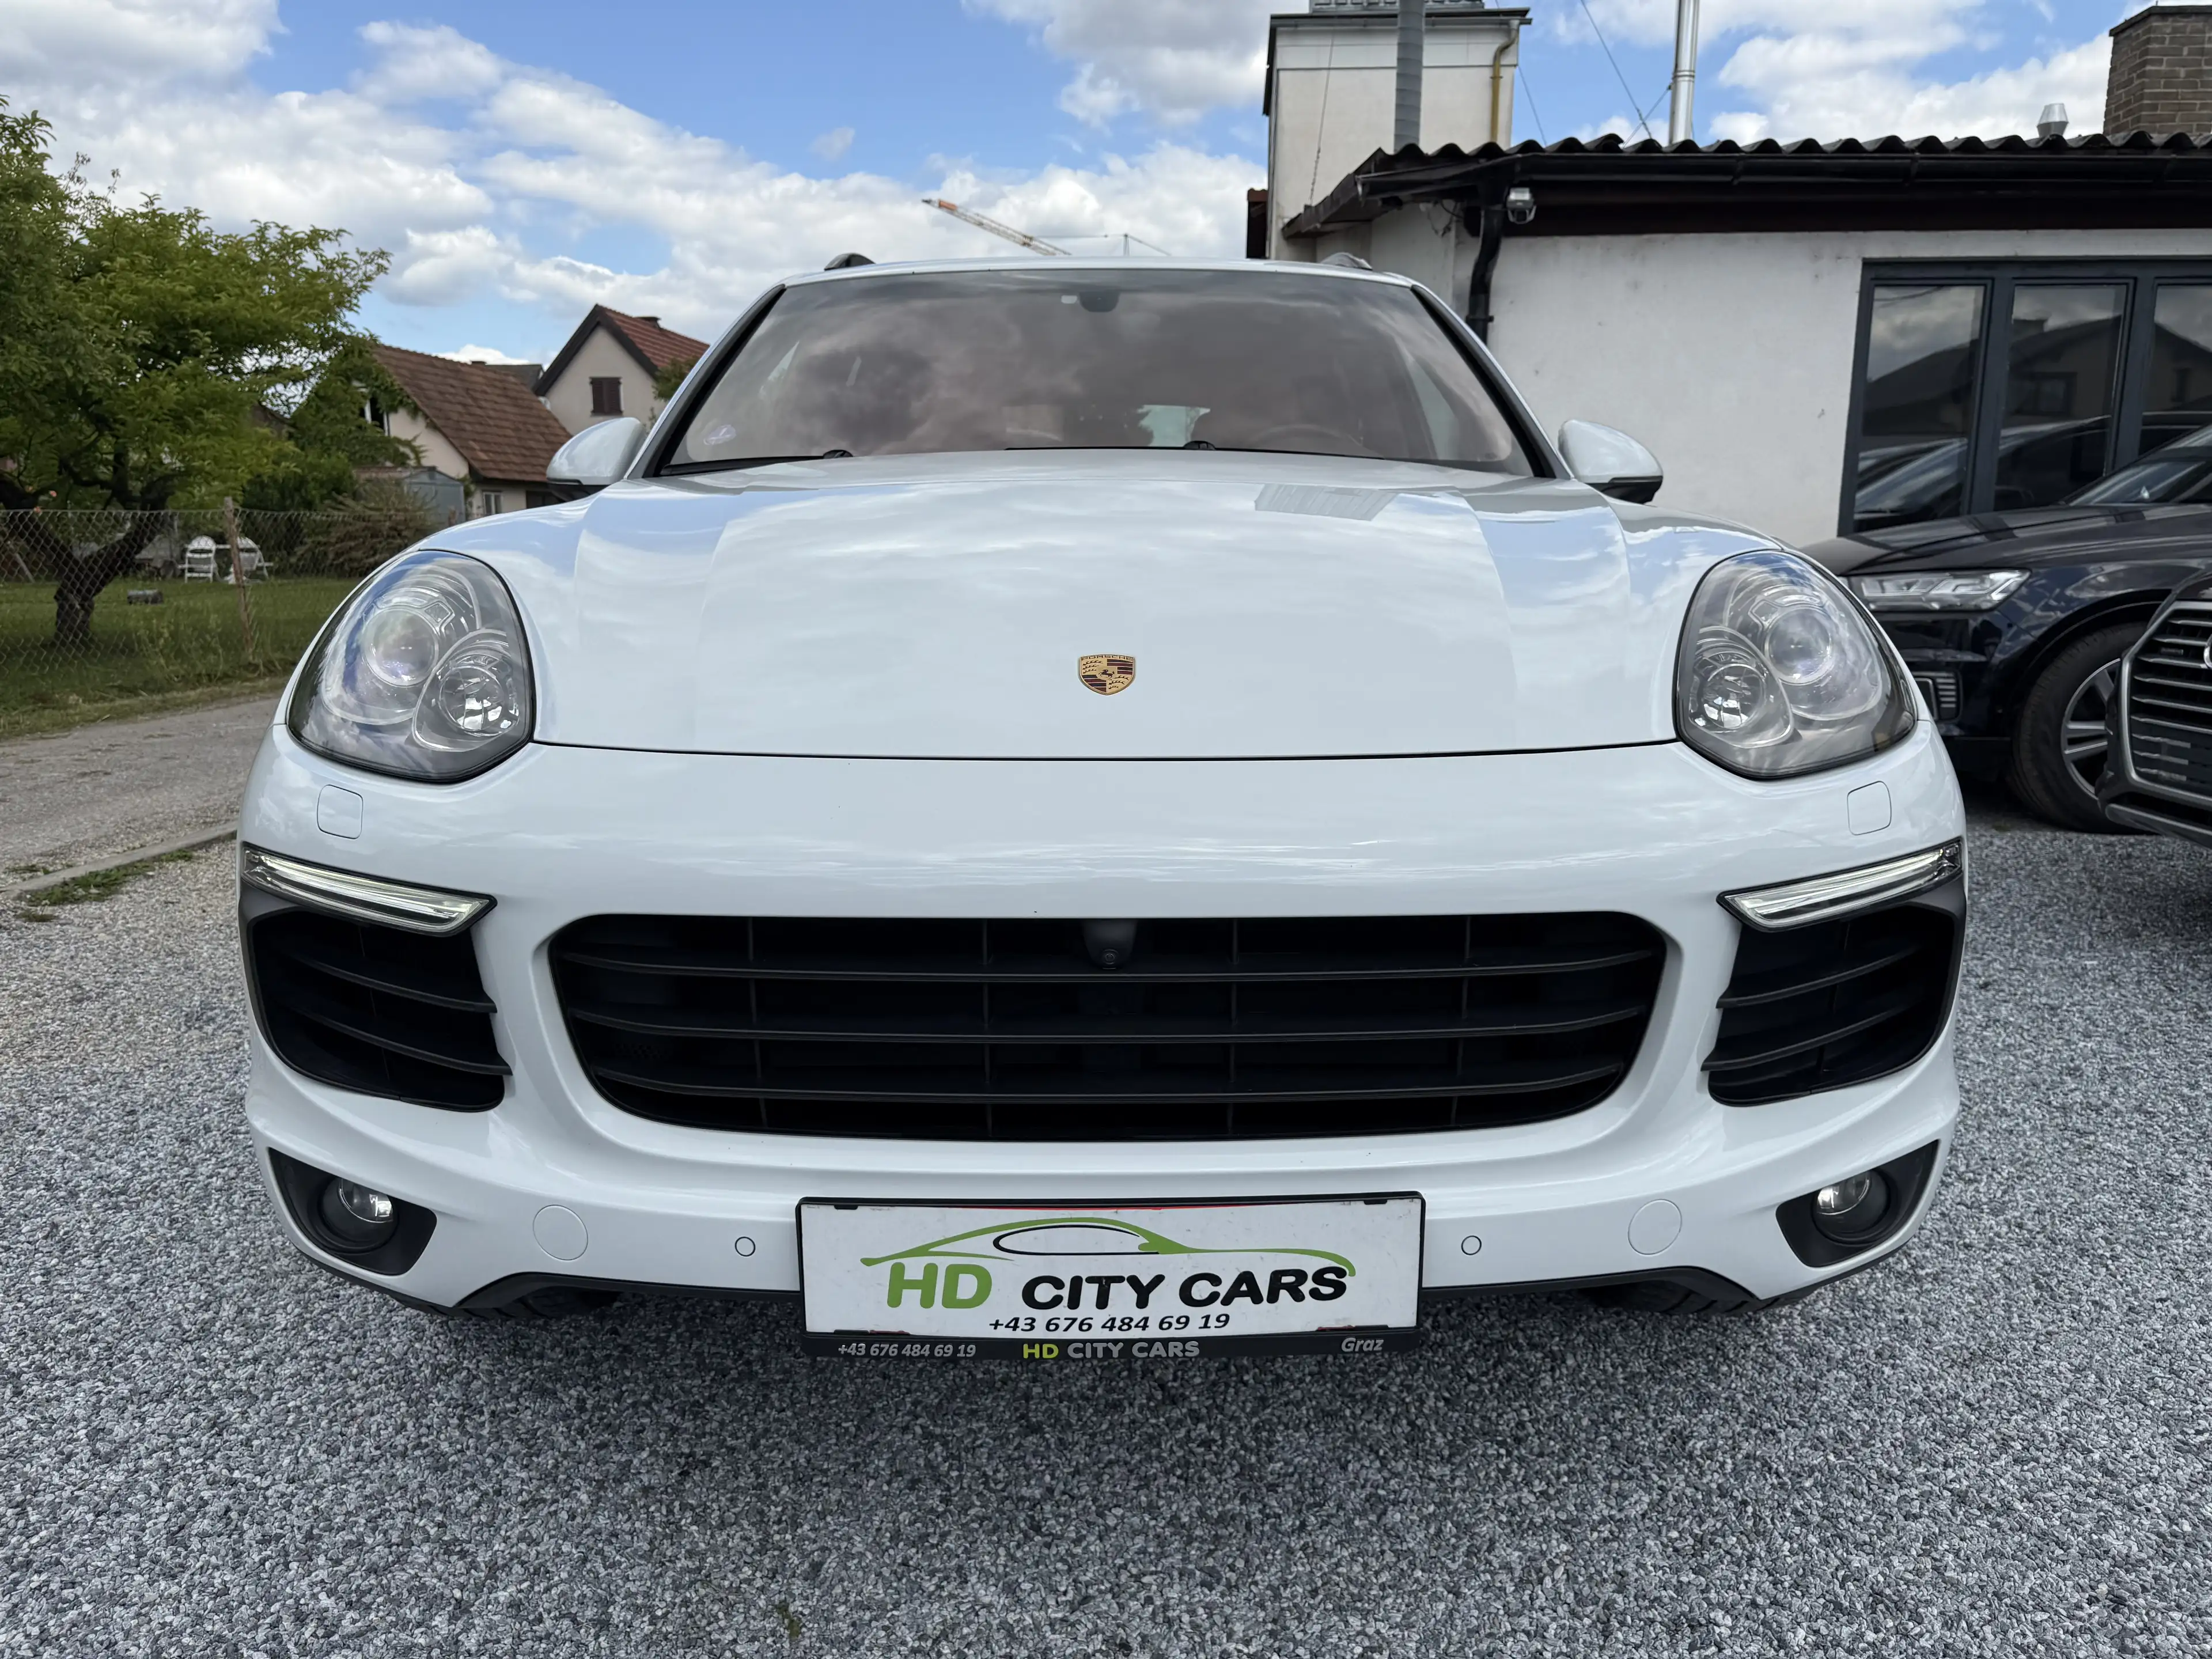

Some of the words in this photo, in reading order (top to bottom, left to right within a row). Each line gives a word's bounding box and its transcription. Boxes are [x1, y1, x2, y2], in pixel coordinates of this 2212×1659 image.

[887, 1262, 992, 1309] HD
[1022, 1274, 1165, 1310] CITY
[1179, 1266, 1347, 1307] CARS
[989, 1316, 1036, 1332] +43
[1045, 1317, 1093, 1332] 676
[1101, 1316, 1150, 1331] 484
[1158, 1315, 1190, 1331] 69
[1198, 1313, 1230, 1329] 19
[838, 1343, 866, 1355] +43
[870, 1344, 898, 1356] 676
[901, 1344, 930, 1357] 484
[934, 1344, 953, 1357] 69
[957, 1344, 976, 1357] 19
[1023, 1343, 1059, 1358] HD
[1067, 1342, 1124, 1358] CITY
[1131, 1341, 1200, 1358] CARS
[1341, 1337, 1384, 1352] Graz
